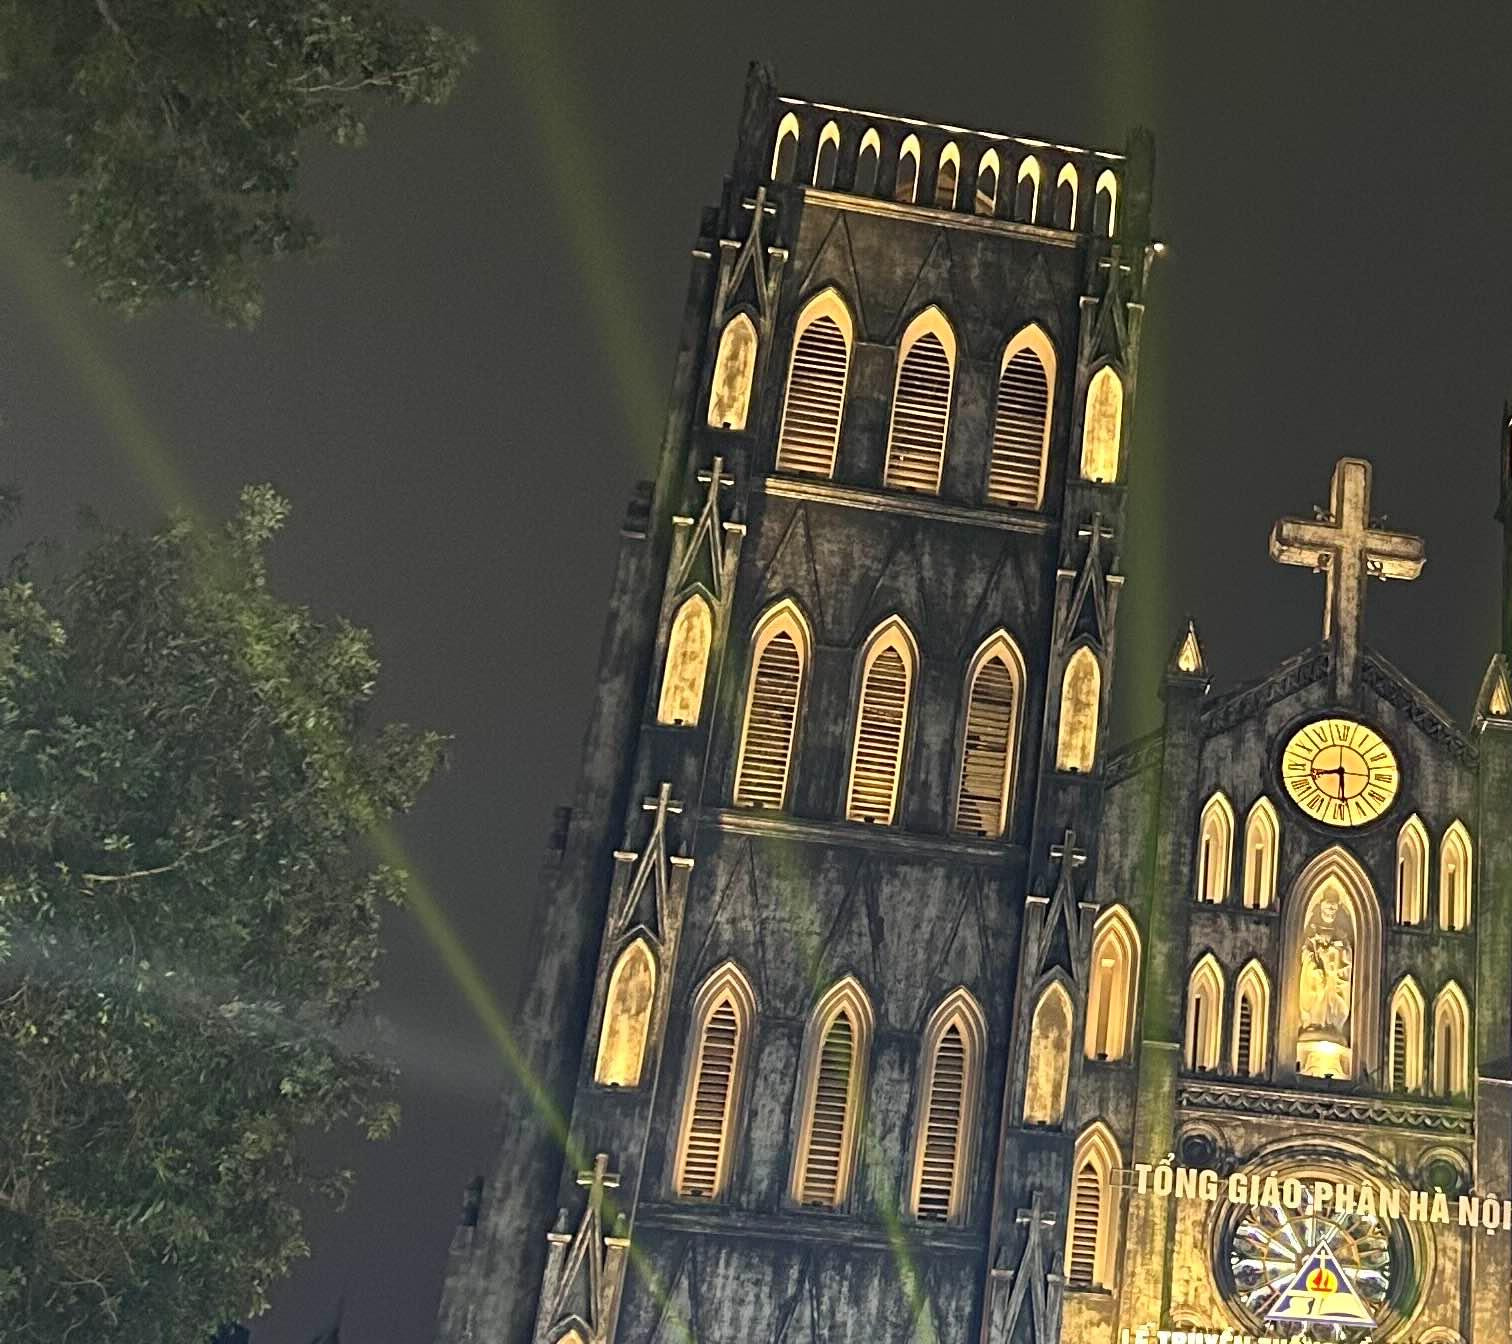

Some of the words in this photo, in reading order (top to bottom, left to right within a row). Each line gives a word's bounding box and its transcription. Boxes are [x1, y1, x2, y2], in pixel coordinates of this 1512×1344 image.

[1135, 1152, 1218, 1201] TỔNG
[1228, 1170, 1301, 1209] GIÁO
[1408, 1186, 1450, 1224] HÀ
[1458, 1192, 1512, 1235] NỘI
